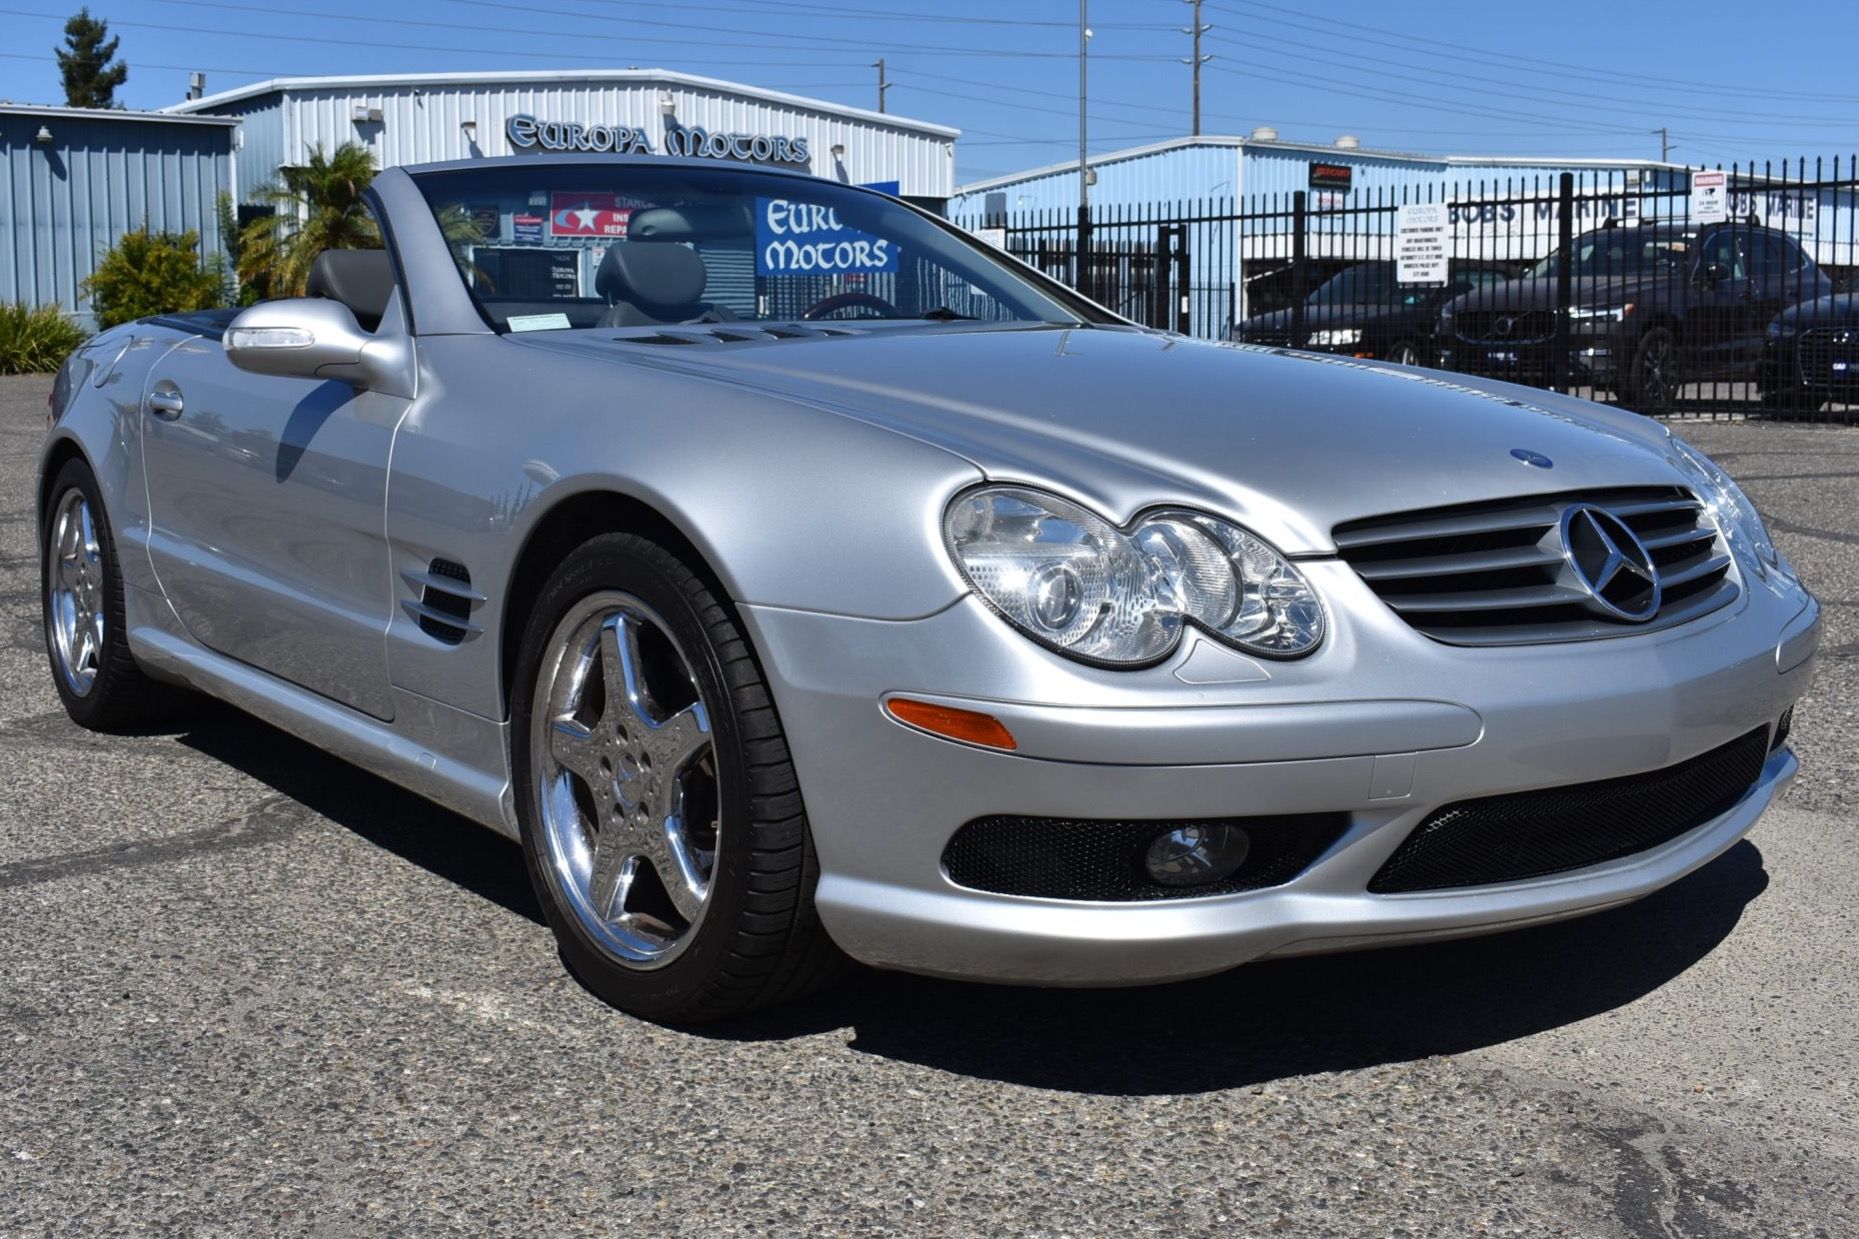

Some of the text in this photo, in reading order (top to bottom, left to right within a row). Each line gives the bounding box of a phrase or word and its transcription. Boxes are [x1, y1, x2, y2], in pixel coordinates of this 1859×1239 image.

[507, 113, 811, 163] EUROPA MOTORS
[767, 199, 860, 235] EUR
[1448, 192, 1636, 224] BOBS MRNE
[1725, 190, 1758, 214] OBS
[765, 239, 888, 270] MOTORS
